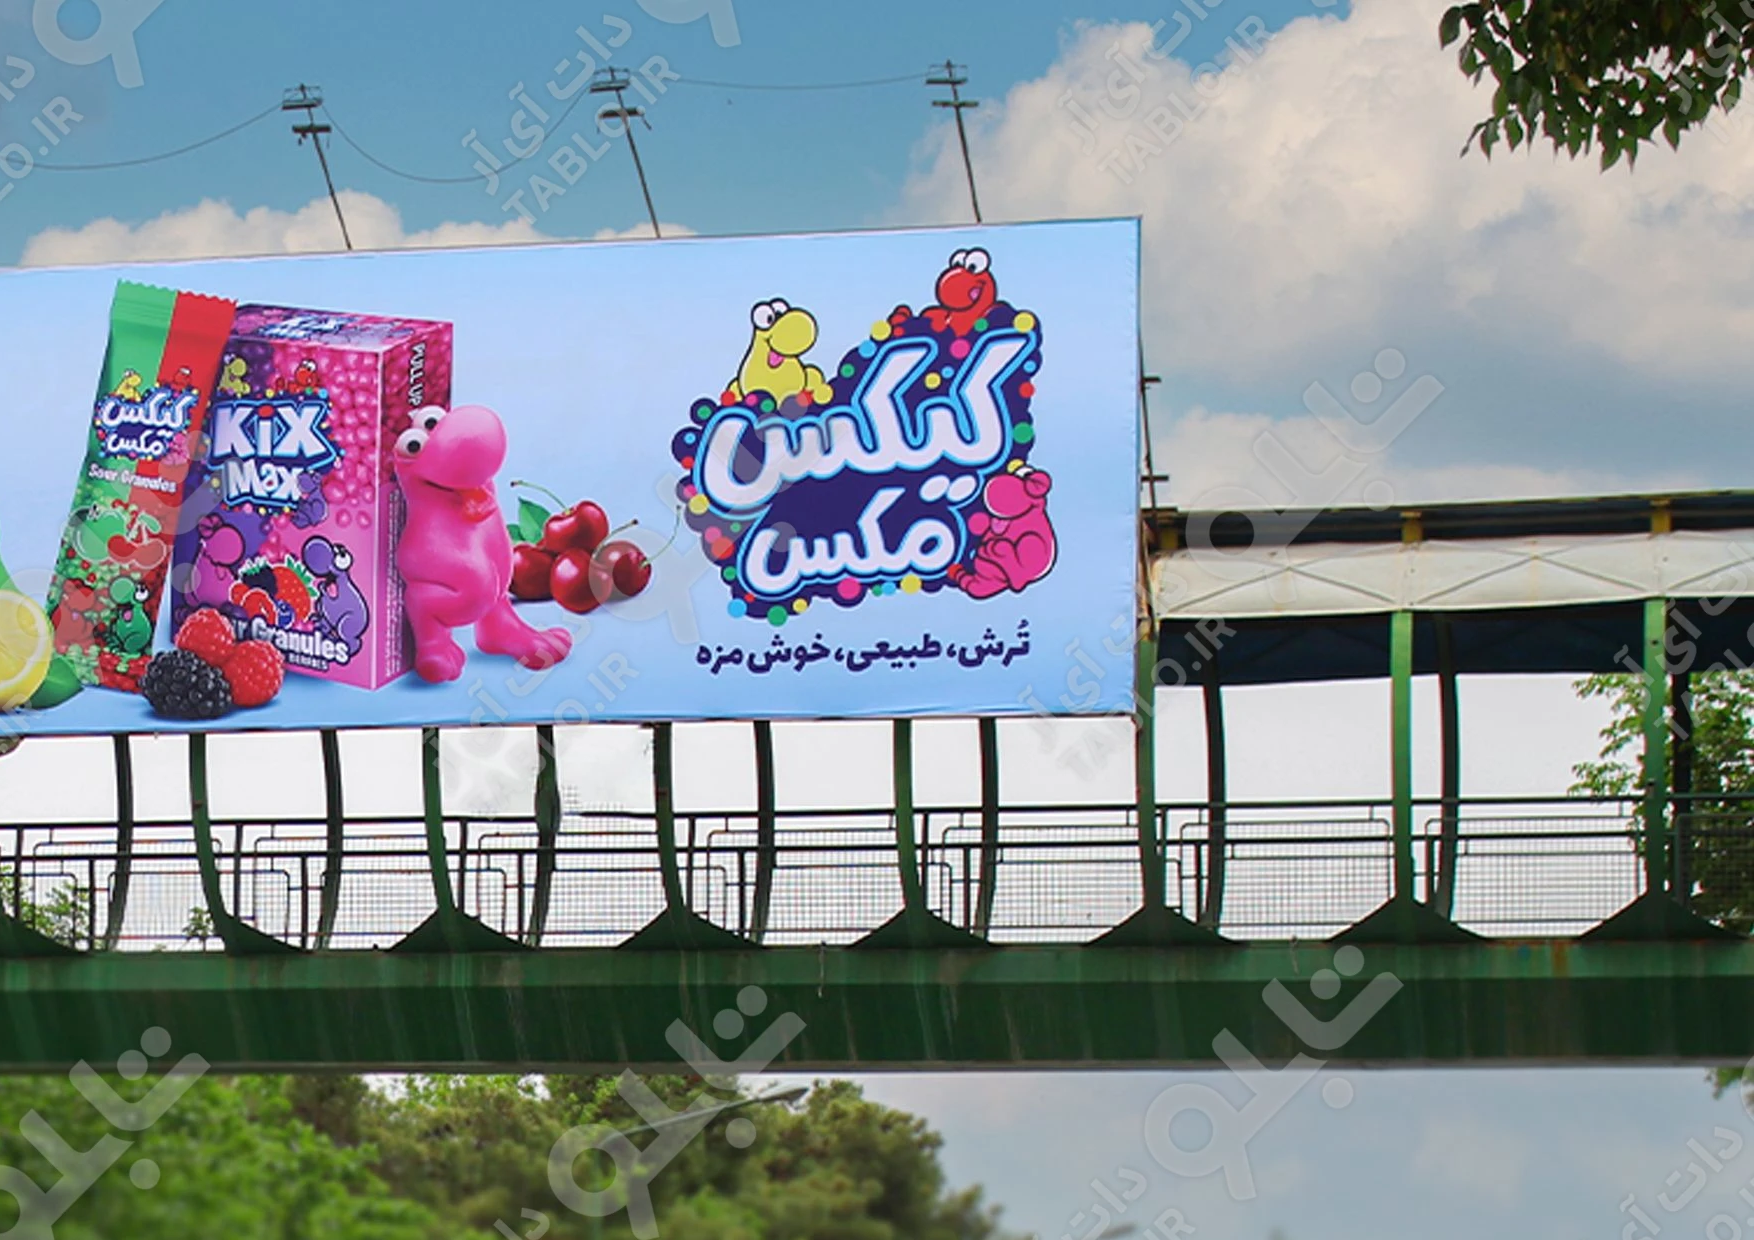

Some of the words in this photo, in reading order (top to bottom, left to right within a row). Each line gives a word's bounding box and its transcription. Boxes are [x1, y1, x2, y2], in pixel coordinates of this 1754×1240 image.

[89, 463, 119, 480] Sour
[228, 458, 305, 500] Max
[747, 487, 956, 593] مکس
[252, 617, 349, 663] Granules
[696, 644, 743, 674] مزه
[747, 633, 830, 673] خوش
